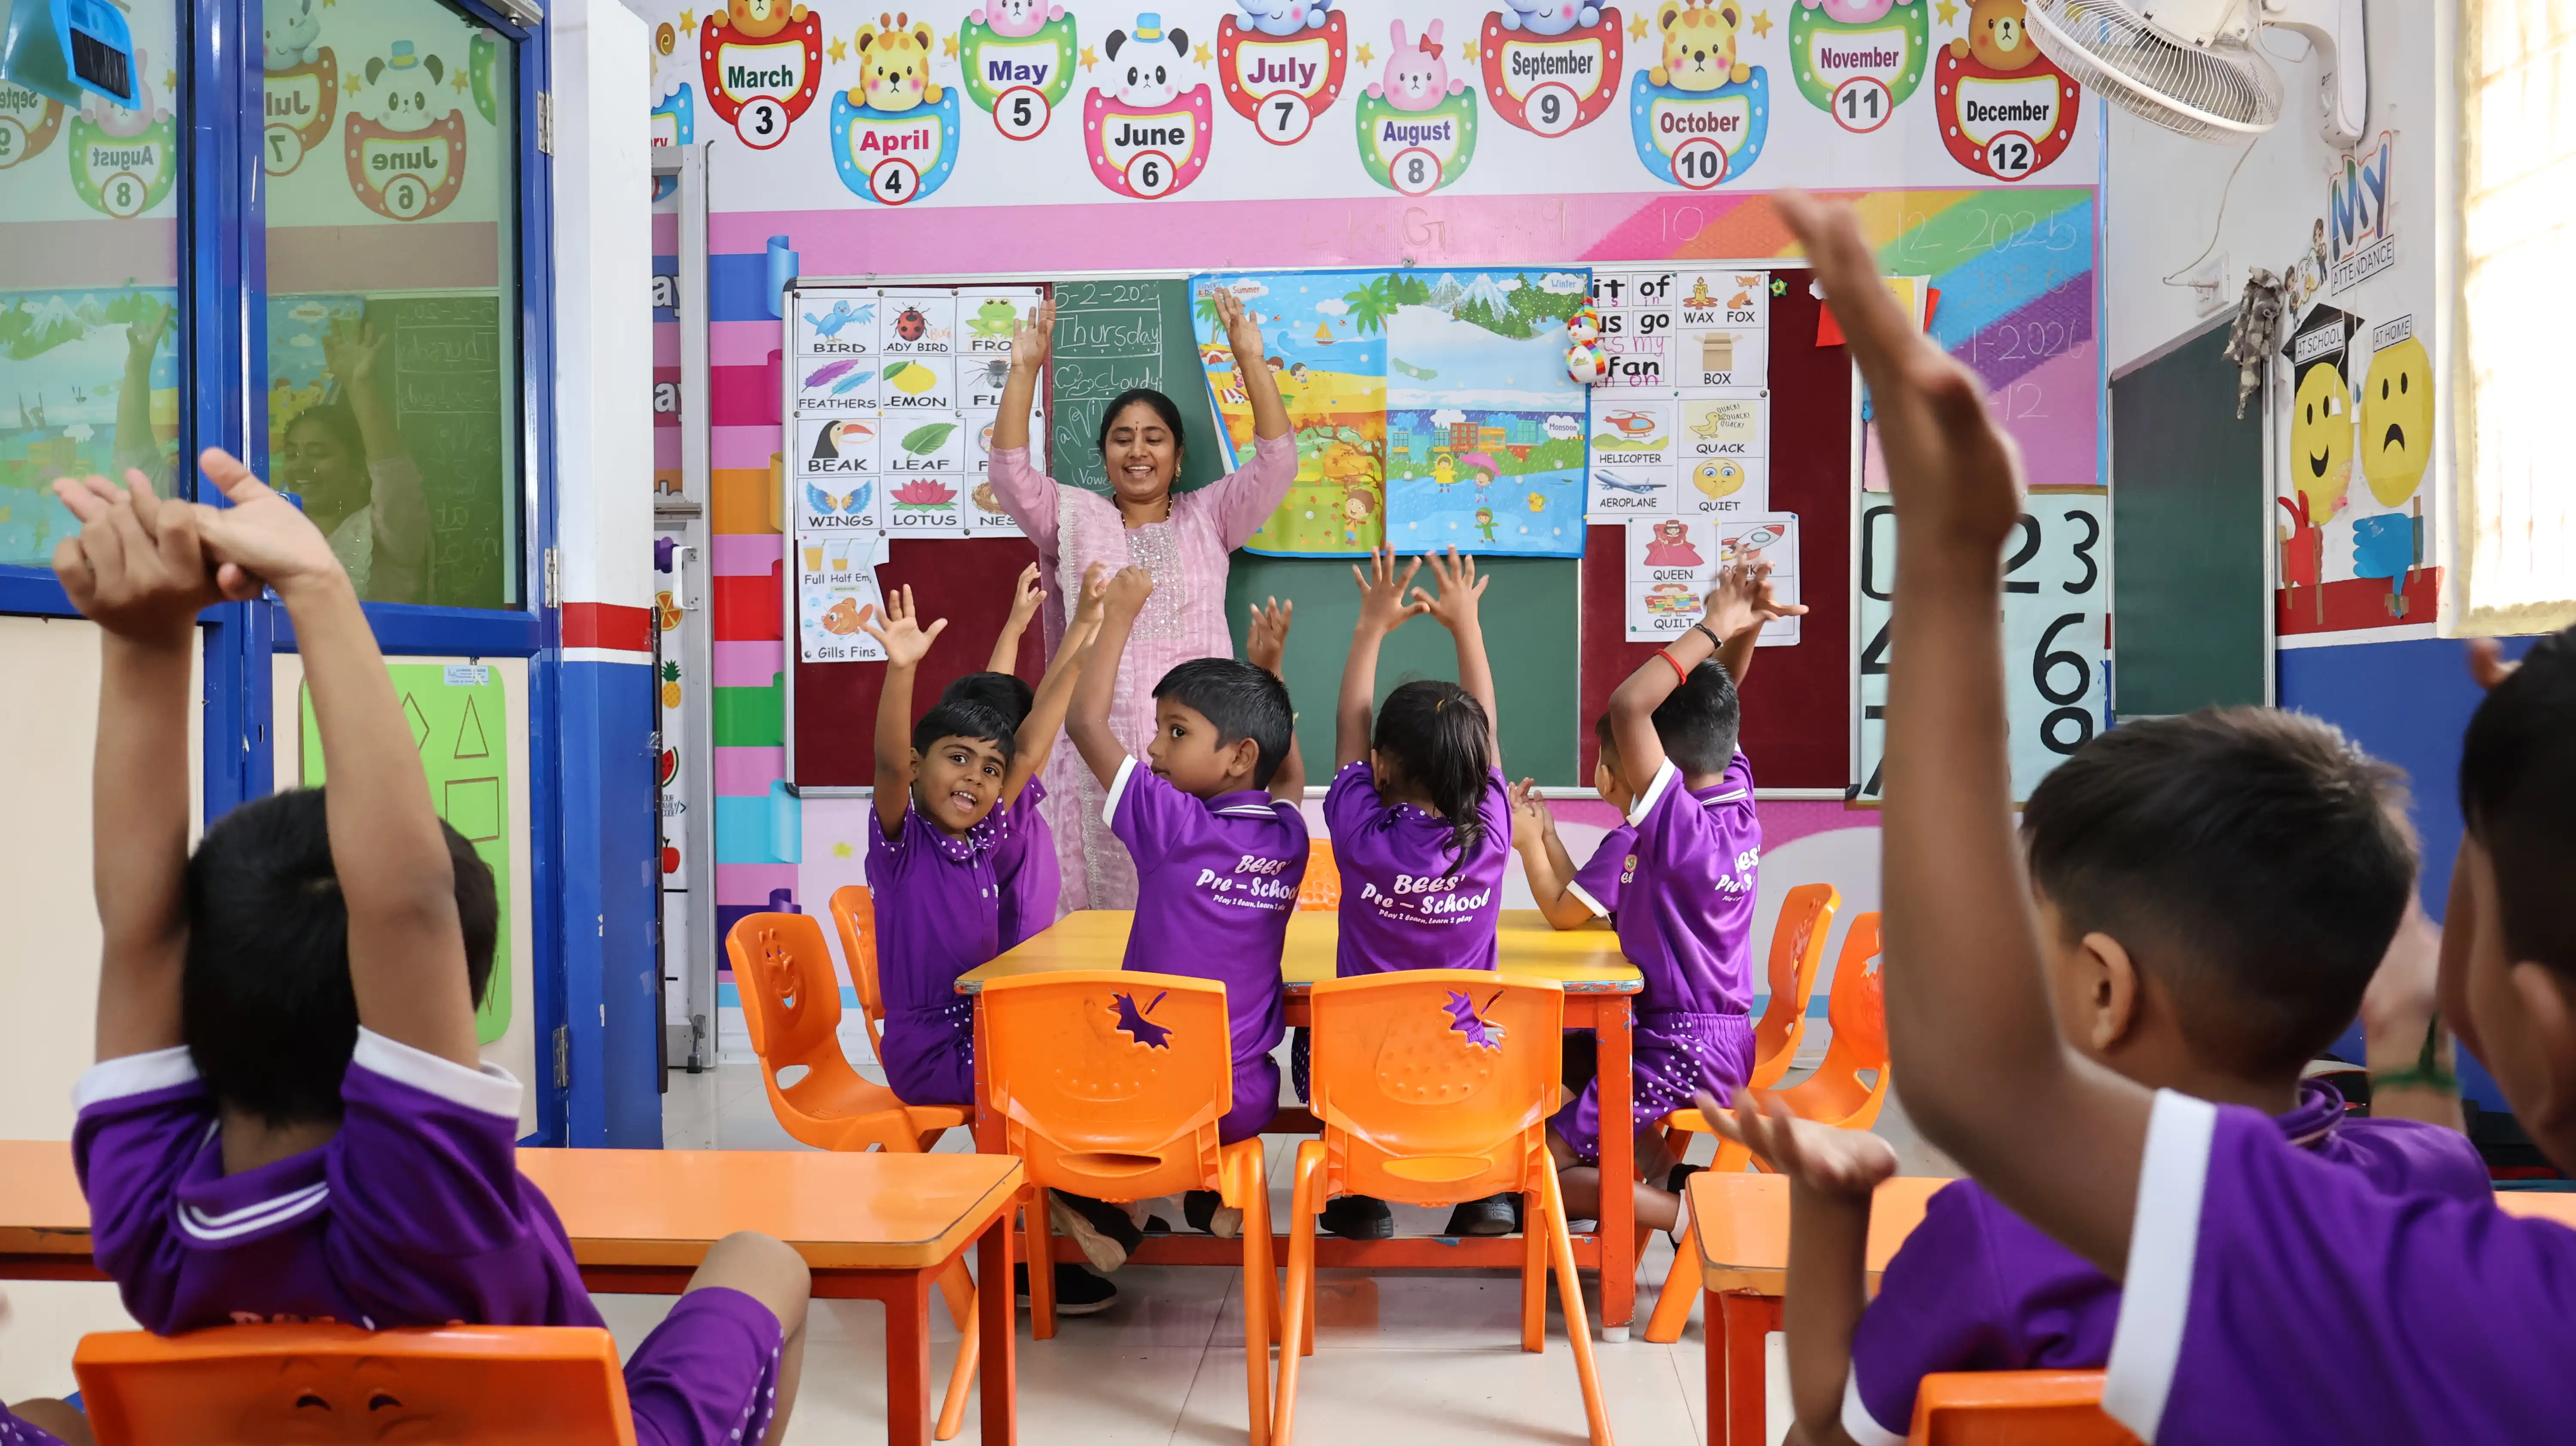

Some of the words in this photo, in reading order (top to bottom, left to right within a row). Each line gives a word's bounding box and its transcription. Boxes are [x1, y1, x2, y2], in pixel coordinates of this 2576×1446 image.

[1512, 50, 1593, 82] September
[1821, 47, 1899, 69] November
[728, 65, 793, 88] March
[989, 61, 1048, 85] May
[1248, 57, 1317, 89] July
[1013, 98, 1031, 126] 5
[1541, 94, 1560, 124] 9
[1842, 89, 1878, 118] 11
[1967, 101, 2049, 122] December
[756, 106, 773, 134] 3
[1275, 103, 1293, 131] 7
[1660, 111, 1740, 135] October
[860, 130, 929, 155] April
[1115, 124, 1185, 147] June
[1383, 120, 1451, 146] August
[1681, 152, 1717, 179] 10
[1993, 143, 2028, 170] 12
[885, 170, 902, 194] 4
[1143, 162, 1159, 187] 6
[1408, 159, 1425, 183] 8
[2332, 143, 2388, 261] MY
[1663, 207, 1703, 241] 10
[1956, 209, 2077, 253] 2025
[2333, 242, 2393, 289] ATTENDANCE
[1551, 279, 1577, 288] Winter
[1593, 279, 1625, 298] it
[1640, 275, 1670, 298] of
[1640, 314, 1669, 334] go
[1684, 312, 1714, 323] WAX
[1727, 311, 1755, 323] FOX
[1056, 315, 1159, 353] Thursday
[2298, 340, 2306, 358] AT
[2308, 327, 2341, 353] SCHOOL
[2376, 331, 2384, 346] AT
[2385, 320, 2409, 340] HOME
[814, 343, 866, 353] BIRD
[884, 343, 911, 351] ADY
[918, 343, 948, 352] BIRD
[972, 340, 1012, 351] FRO
[1633, 336, 1664, 357] my
[1608, 356, 1659, 377] fan
[1704, 373, 1731, 385] BOX
[799, 398, 876, 409] FEATHERS
[974, 395, 1000, 405] FL
[1716, 403, 1740, 413] QUACK!
[1726, 412, 1750, 421] QUACK!
[1600, 454, 1661, 464] HELICOPTER
[1696, 444, 1745, 454] QUACK
[808, 458, 868, 471] BEAK
[893, 459, 950, 471] LEAF
[1600, 497, 1657, 508] AEROPLANE
[1699, 501, 1741, 512] QUIET
[808, 515, 873, 527] WINGS
[893, 515, 957, 526] LOTUS
[980, 516, 1016, 526] NES
[2063, 510, 2099, 595] 3
[805, 574, 824, 584] Full
[831, 574, 852, 583] Half
[1653, 570, 1693, 581] QUEEN
[1654, 619, 1694, 630] QUILT
[819, 647, 844, 658] Gills
[851, 647, 876, 657] Fins
[2033, 613, 2090, 705] 6
[1196, 869, 1232, 891] Pre
[1213, 895, 1231, 905] Play
[1257, 901, 1273, 909] Learn
[1361, 883, 1393, 908] Pre
[1420, 887, 1491, 914] School
[1379, 909, 1397, 919] Play
[1456, 915, 1473, 924] play
